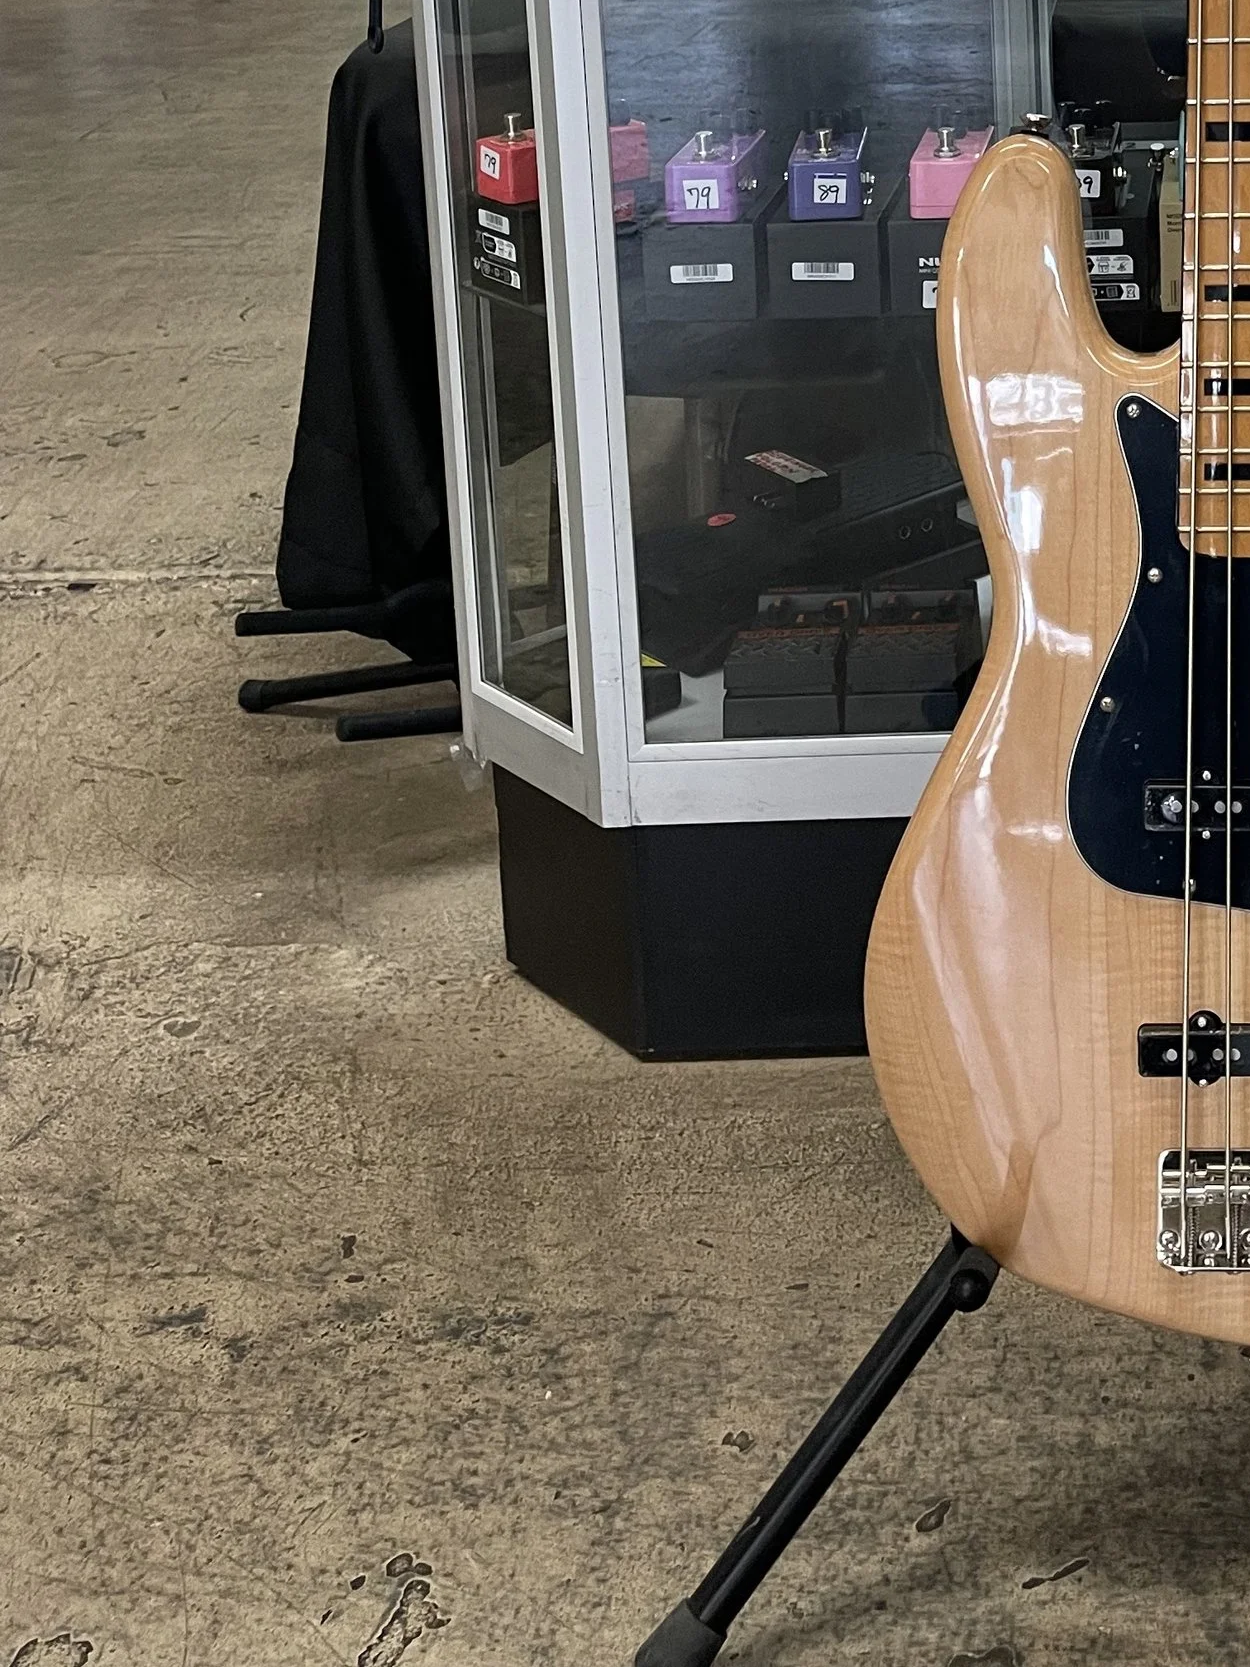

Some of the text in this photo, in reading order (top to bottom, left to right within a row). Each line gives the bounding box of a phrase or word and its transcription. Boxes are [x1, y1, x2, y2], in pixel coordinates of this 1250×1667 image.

[484, 153, 498, 175] 79
[686, 185, 712, 210] 79
[817, 183, 840, 204] 89
